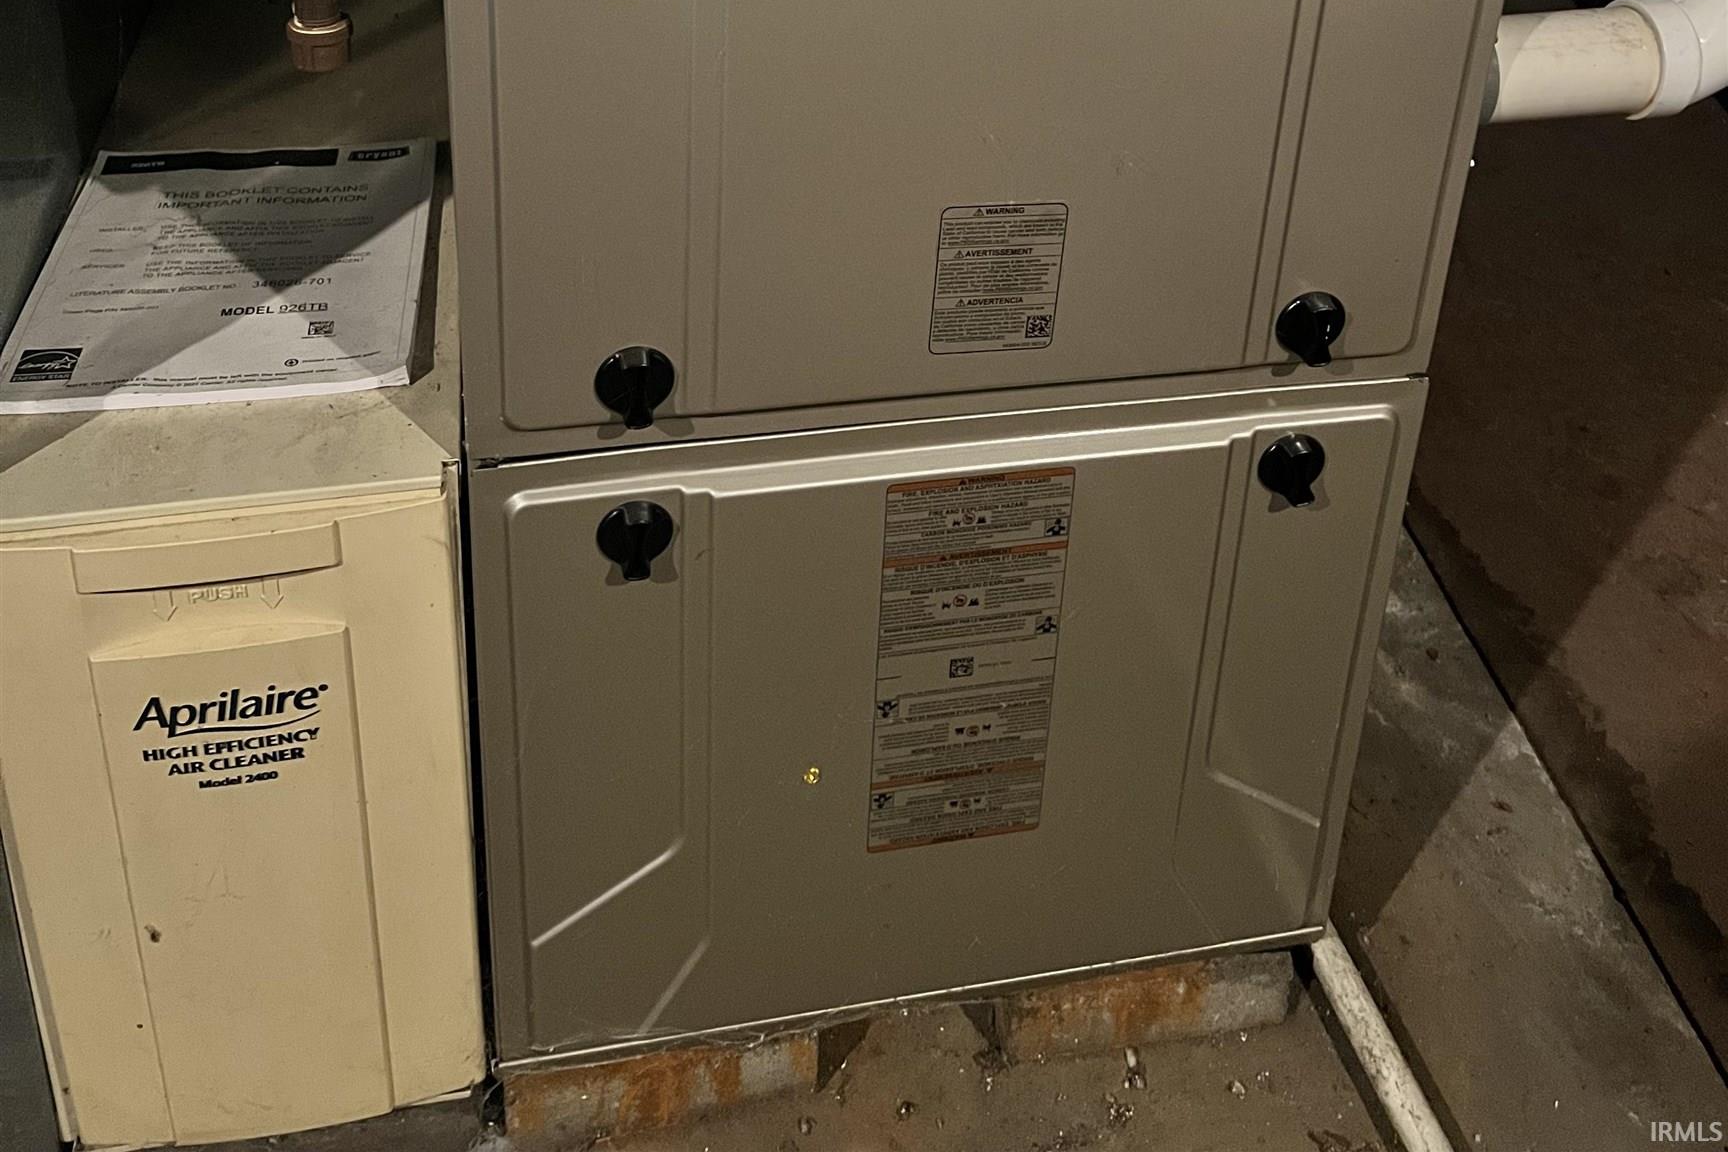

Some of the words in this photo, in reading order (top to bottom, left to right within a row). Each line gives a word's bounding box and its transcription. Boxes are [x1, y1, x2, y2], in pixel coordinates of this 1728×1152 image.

[164, 191, 200, 199] THIS
[205, 186, 279, 199] BOOKLET
[287, 184, 369, 194] CONTAINS
[157, 197, 250, 209] IMPORTANT
[257, 194, 368, 205] INFORMATION
[985, 207, 1025, 215] WARNING
[965, 248, 1034, 257] AVERTISSEMENT
[966, 297, 1024, 306] ADVERTENCIA
[221, 306, 275, 317] MODEL
[187, 584, 249, 605] PUSH
[132, 684, 320, 739] Aprilaire
[142, 744, 198, 762] HIGH
[203, 726, 321, 756] EFFICIENCY
[168, 760, 205, 776] AIR
[208, 747, 306, 771] CLEANER
[199, 775, 242, 789] Model
[245, 770, 279, 784] 2400
